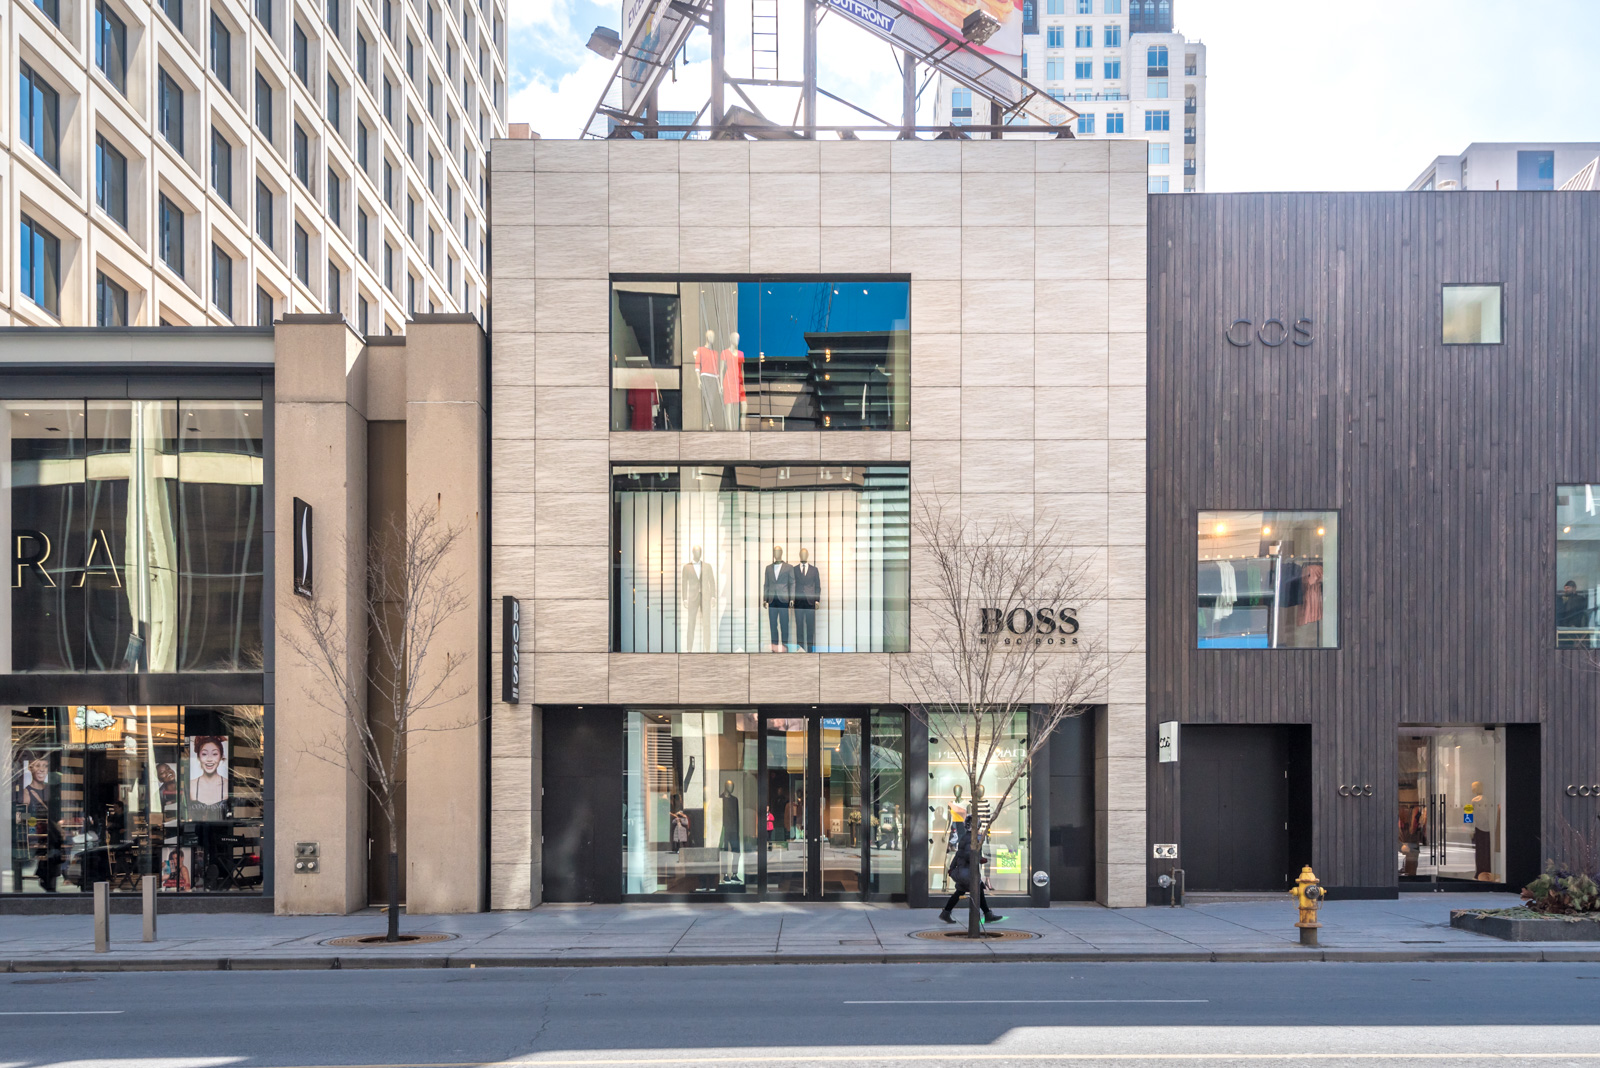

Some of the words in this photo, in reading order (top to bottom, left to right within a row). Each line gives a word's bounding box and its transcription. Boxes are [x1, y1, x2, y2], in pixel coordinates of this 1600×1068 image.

[1225, 318, 1314, 347] COS
[11, 529, 122, 587] RA
[980, 607, 1079, 634] BOSS
[980, 637, 1022, 645] HGO
[1035, 637, 1078, 645] BOSS
[1338, 784, 1373, 797] COS
[1566, 784, 1600, 797] COS
